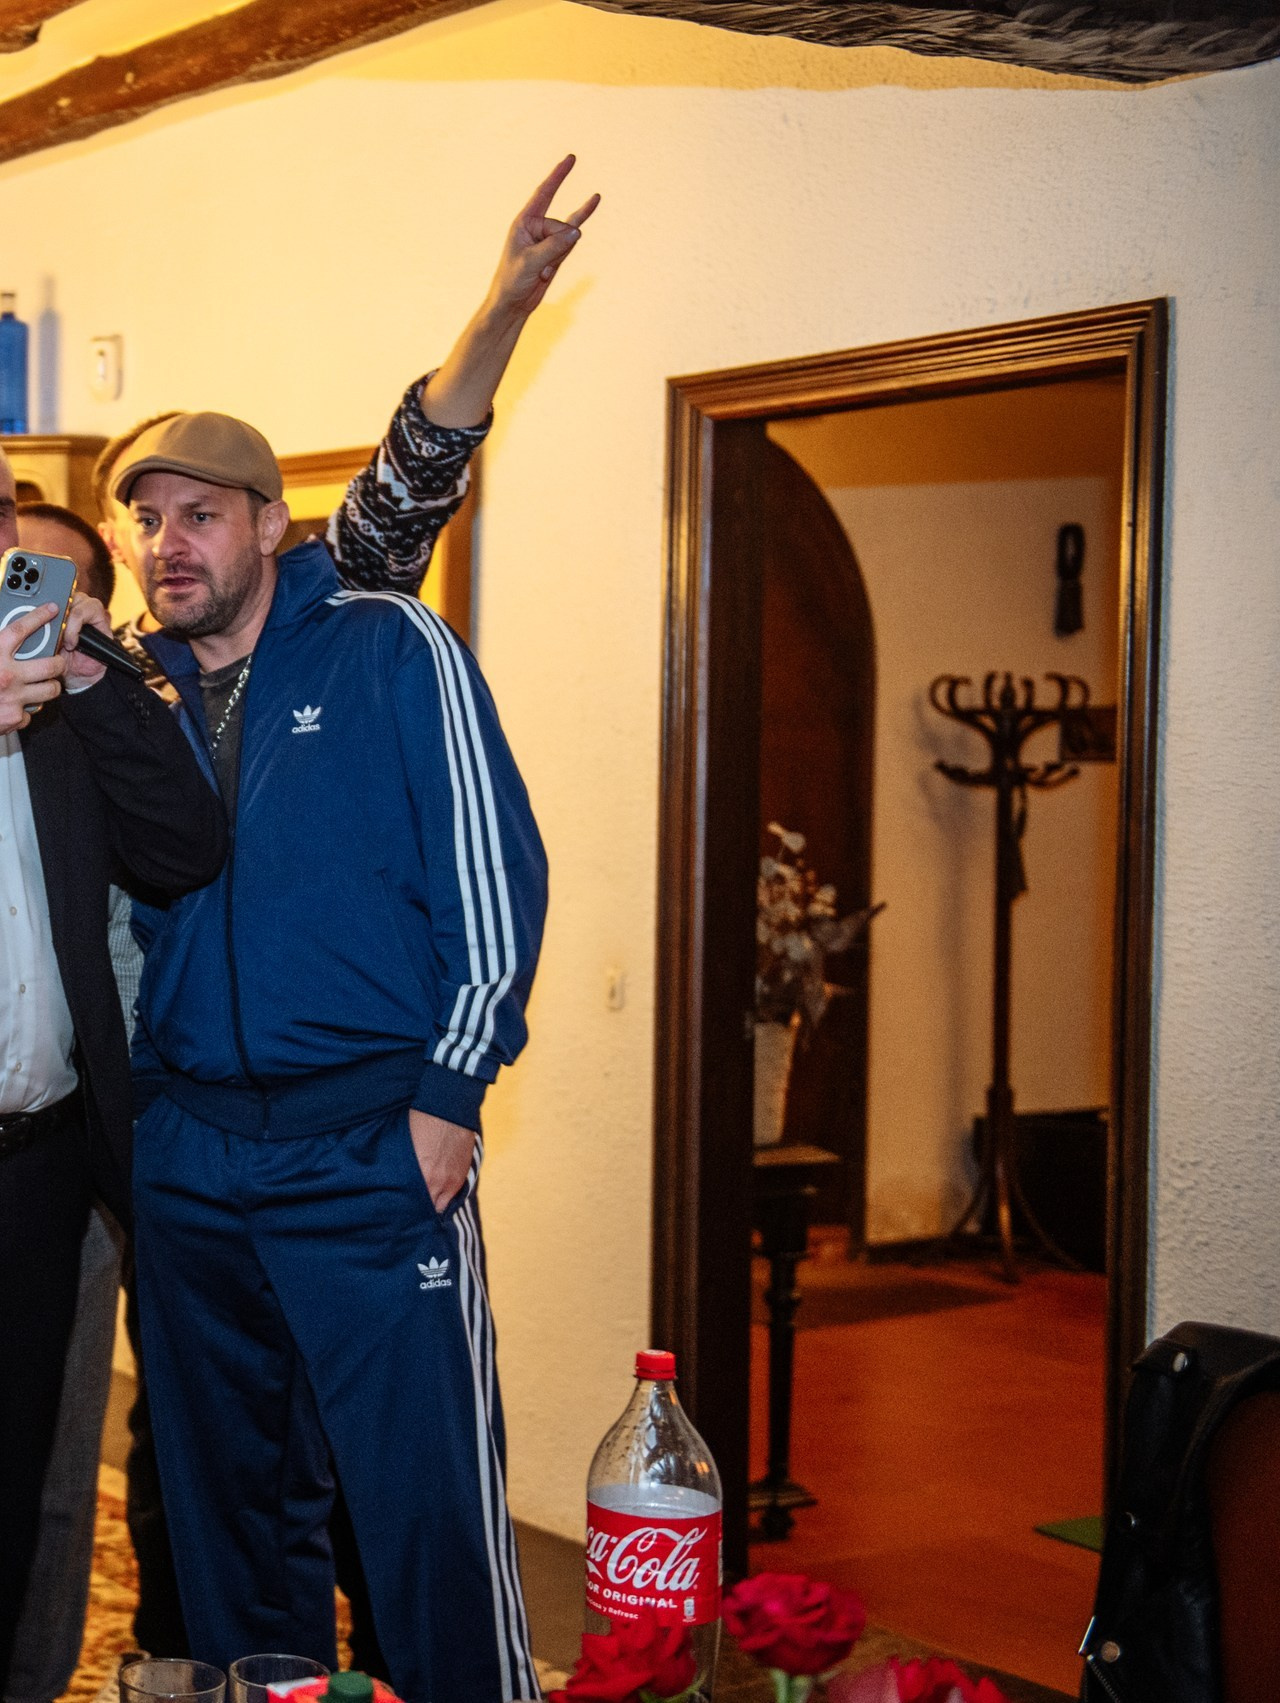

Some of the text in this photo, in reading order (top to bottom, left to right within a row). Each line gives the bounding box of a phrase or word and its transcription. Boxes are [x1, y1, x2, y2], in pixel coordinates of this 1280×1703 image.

[292, 723, 321, 734] adidas
[420, 1278, 452, 1290] adidas
[603, 1588, 678, 1608] ORIGINAL
